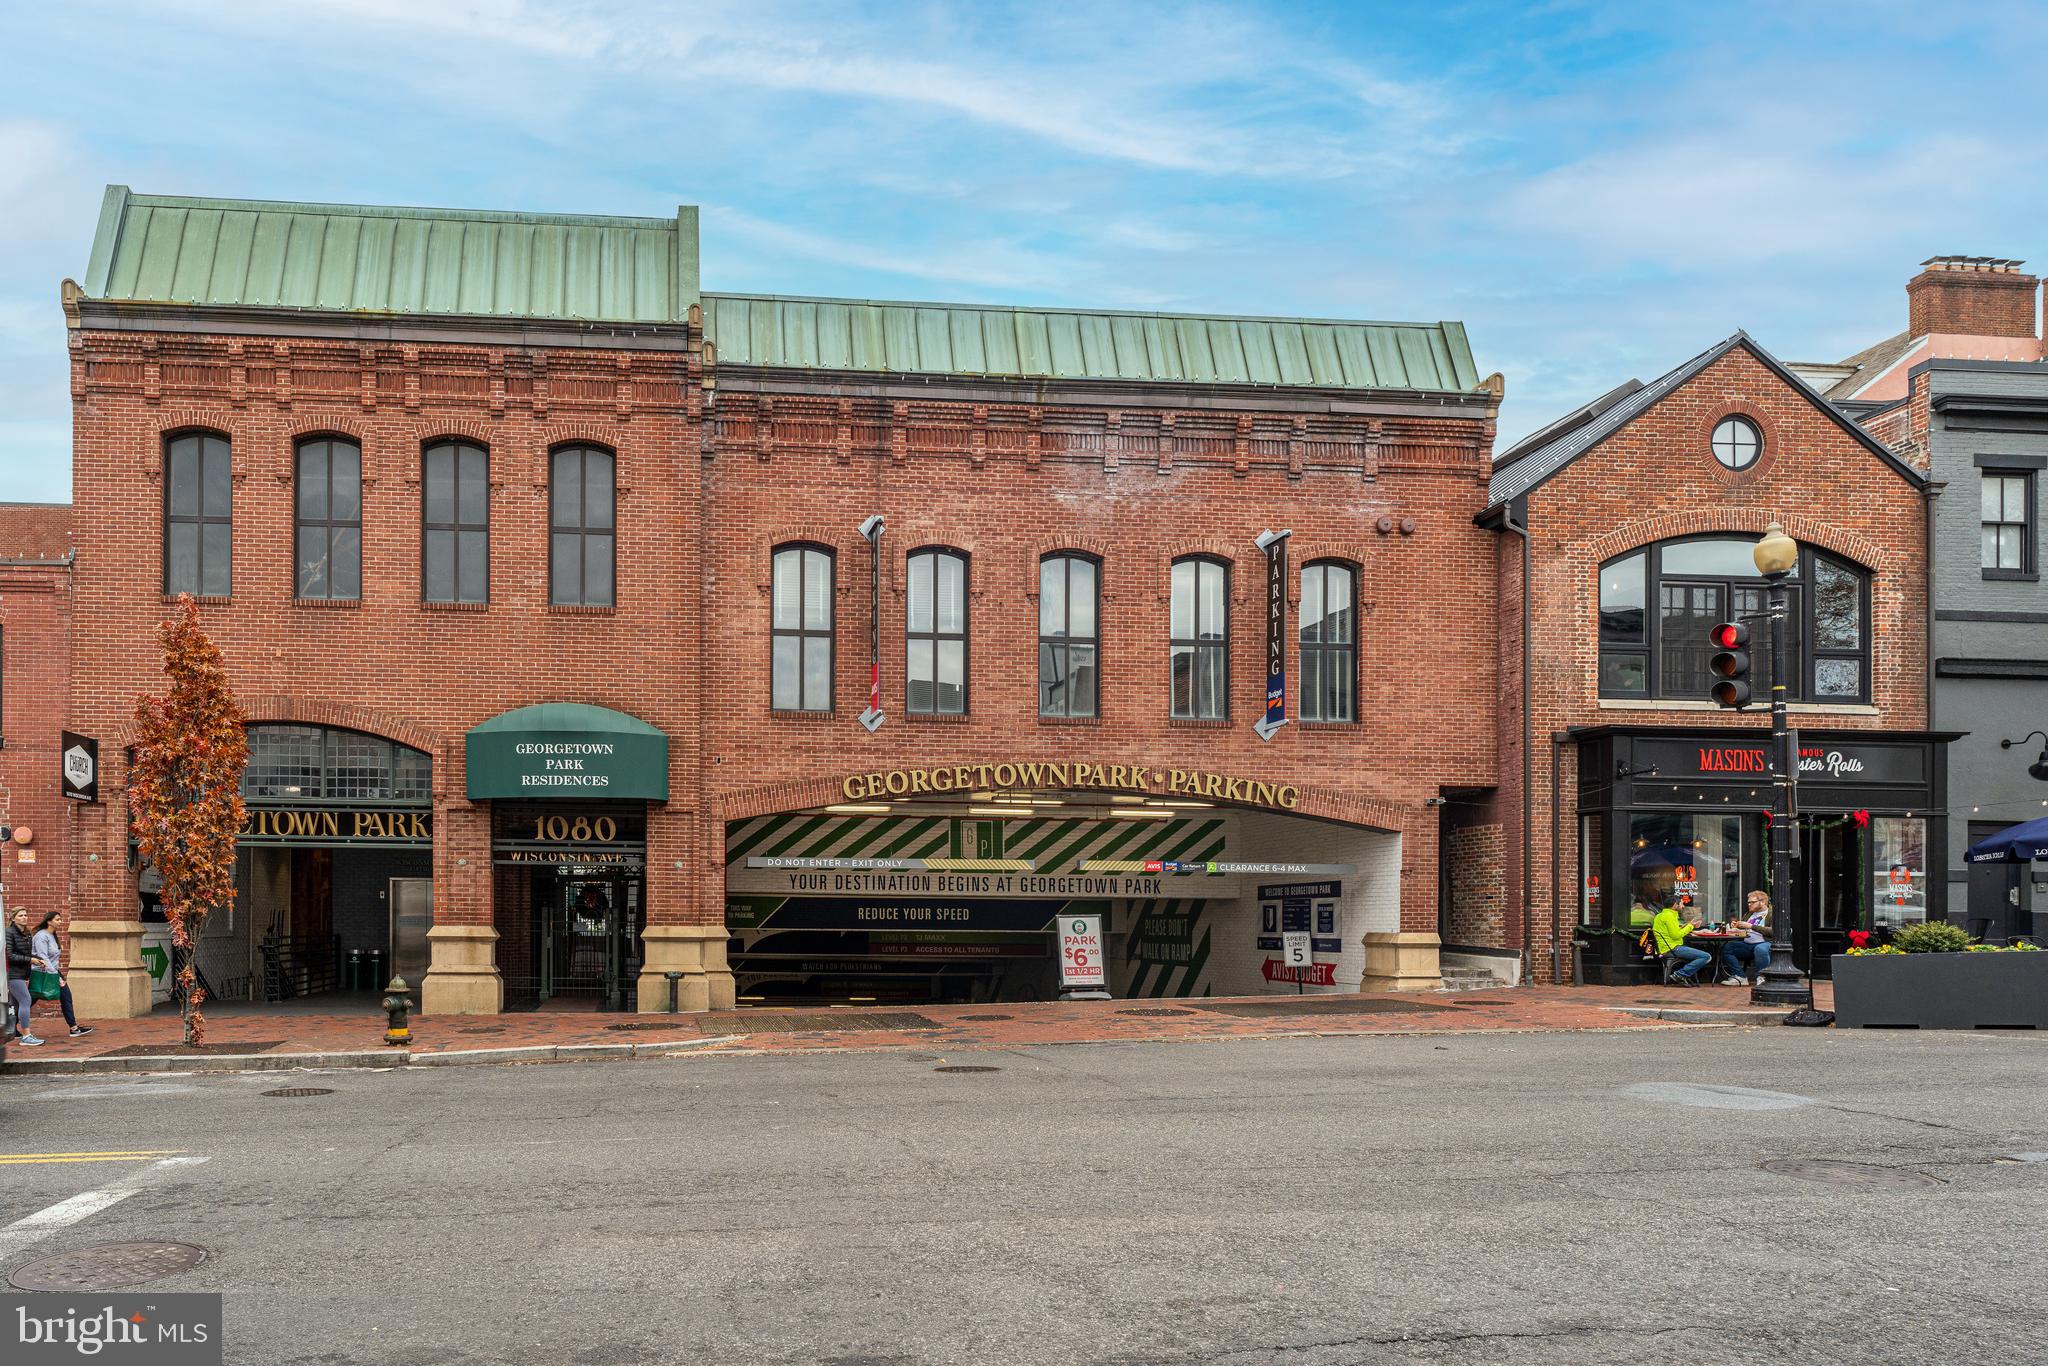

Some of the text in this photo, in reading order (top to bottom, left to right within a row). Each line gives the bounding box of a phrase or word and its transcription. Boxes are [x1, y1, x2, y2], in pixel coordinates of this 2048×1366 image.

[1271, 545, 1280, 676] PARKING
[1268, 688, 1283, 699] Budget
[516, 743, 614, 754] GEORGETOWN
[69, 754, 89, 776] CHURCH
[545, 759, 584, 770] PARK
[1699, 748, 1765, 772] MASON'S
[1827, 751, 1864, 777] Rolls
[521, 775, 609, 786] RESIDENCES
[843, 763, 1300, 809] GEORGETOWN PARK PARKING
[353, 812, 432, 838] PARK
[535, 815, 617, 842] 1080
[511, 851, 592, 862] WISCONSIN
[2035, 848, 2048, 856] LO
[767, 858, 782, 866] DO
[784, 858, 805, 867] NOT
[809, 859, 841, 867] ENTER
[852, 859, 874, 867] EXIT
[877, 859, 903, 867] ONLY
[1219, 864, 1270, 872] CLEARANCE
[789, 874, 1161, 894] YOUR DESTINATION BEGINS AT GEORGETOWN PARK
[858, 907, 970, 921] REDUCE YOUR SPEED
[1144, 919, 1167, 936] PLEASE
[1064, 935, 1097, 945] PARK
[1142, 943, 1191, 961] WALK ON RAMP
[1293, 948, 1304, 962] 5
